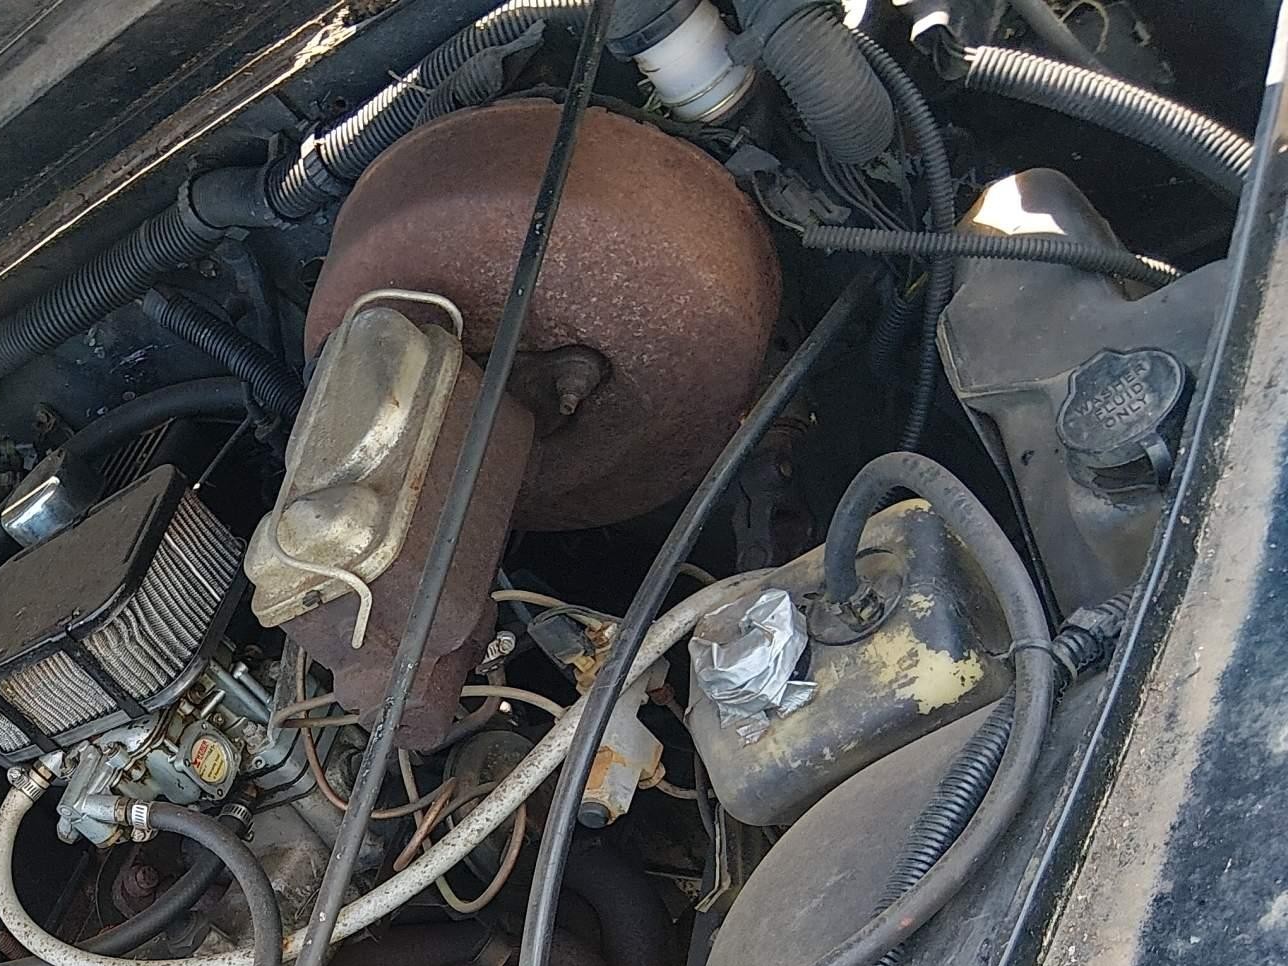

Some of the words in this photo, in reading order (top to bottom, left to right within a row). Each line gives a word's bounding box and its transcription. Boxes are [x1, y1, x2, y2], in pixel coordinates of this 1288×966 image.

[1075, 361, 1148, 416] WASHER
[1095, 382, 1145, 422] FLUID
[1104, 394, 1148, 429] ONLY
